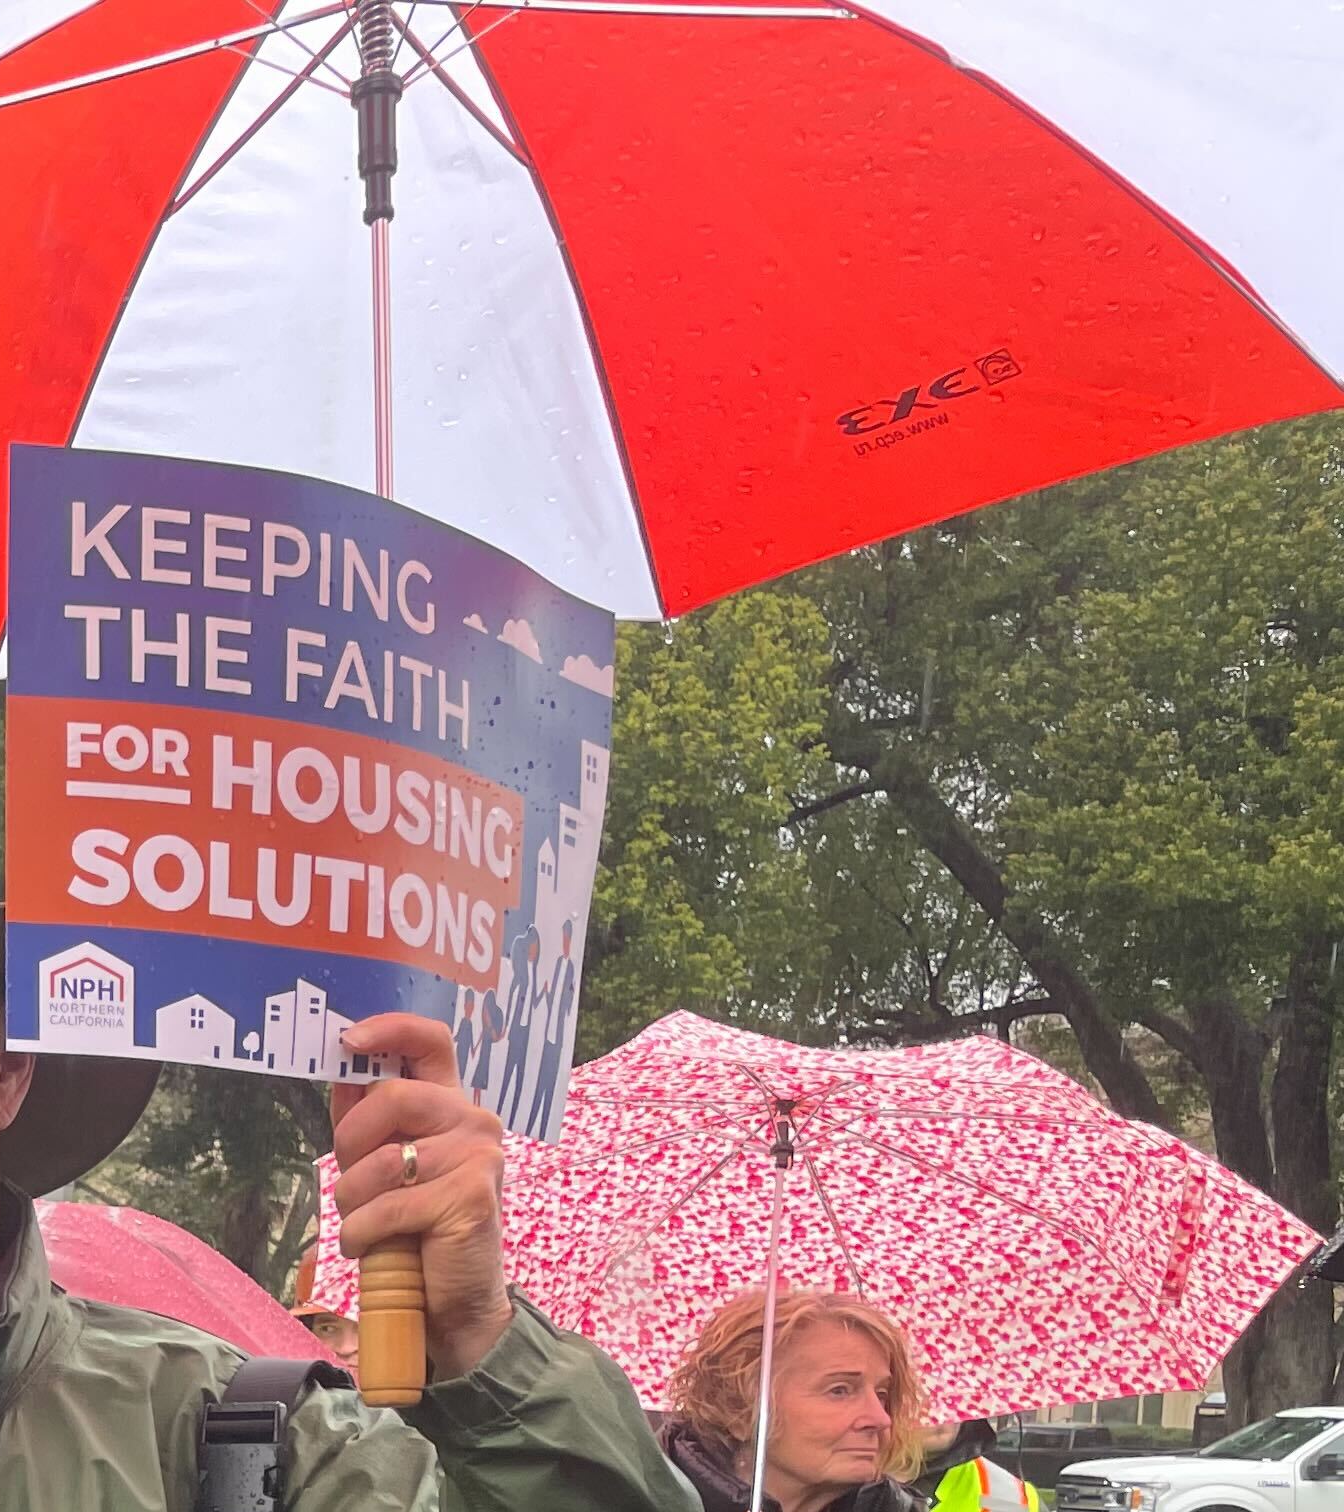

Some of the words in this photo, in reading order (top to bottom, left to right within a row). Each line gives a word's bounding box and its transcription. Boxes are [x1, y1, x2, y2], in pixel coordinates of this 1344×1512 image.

[70, 501, 437, 635] KEEPING
[64, 604, 252, 695] THE
[285, 626, 471, 750] FAITH
[66, 721, 190, 777] FOR
[212, 734, 514, 879] HOUSING
[67, 828, 497, 974] SOLUTIONS
[49, 1002, 125, 1017] NORTHERN
[49, 1014, 125, 1029] CALIFORNIA
[60, 977, 114, 1001] NPH
